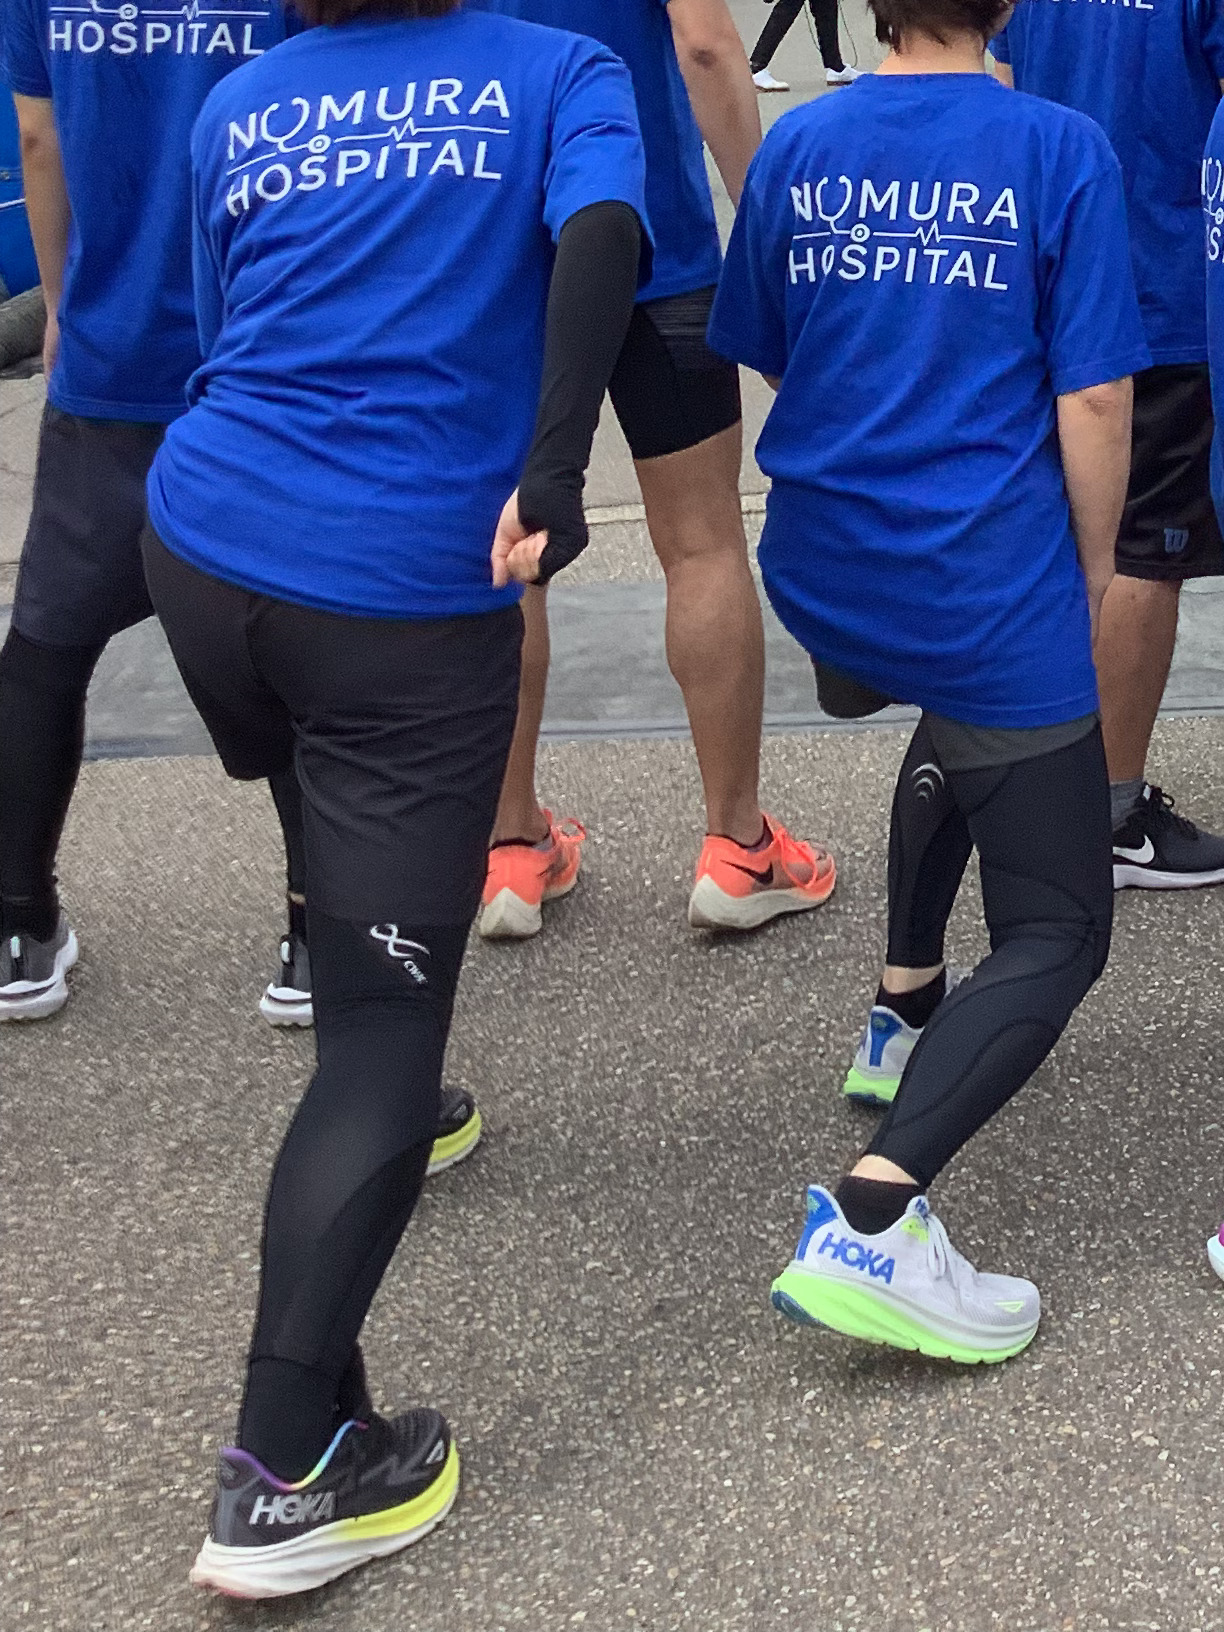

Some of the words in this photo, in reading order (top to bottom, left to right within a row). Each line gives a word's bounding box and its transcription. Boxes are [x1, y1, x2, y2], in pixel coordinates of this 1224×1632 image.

[49, 19, 265, 55] HOSPITAL
[226, 77, 510, 160] NOMURA
[226, 138, 502, 217] HOSPITAL
[790, 175, 1019, 229] NOMURA
[788, 243, 1008, 291] HOSPITAL
[817, 1231, 896, 1285] HOKA
[249, 1491, 336, 1525] HOKA
